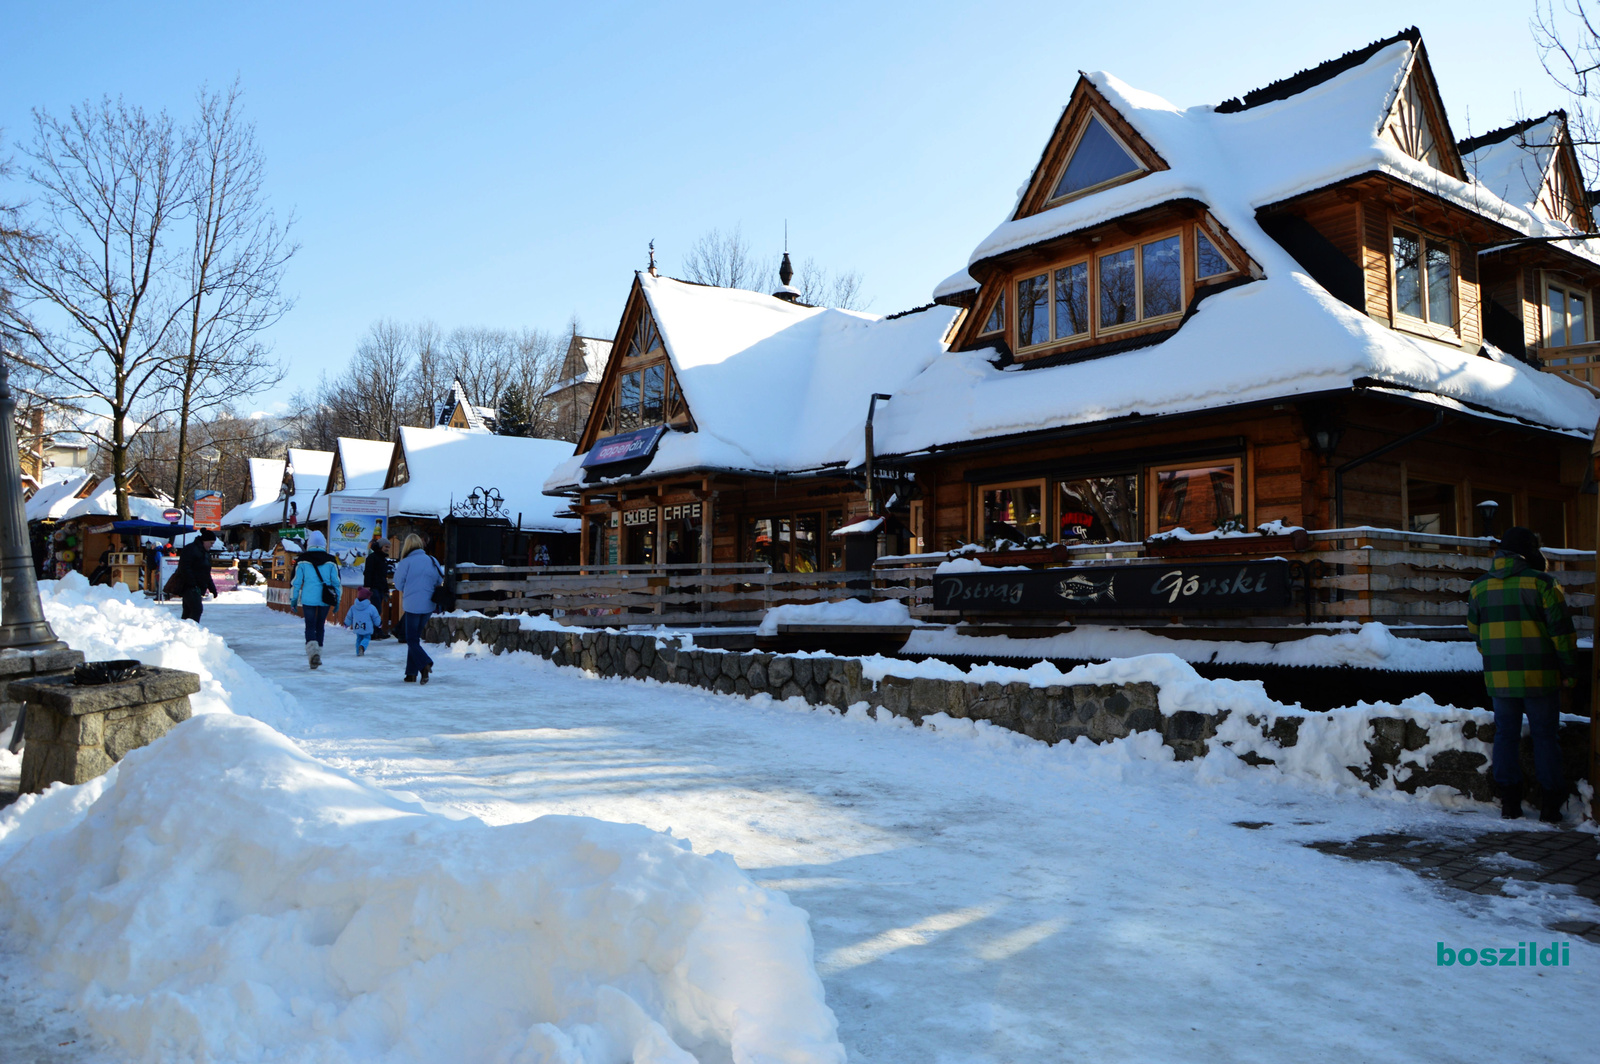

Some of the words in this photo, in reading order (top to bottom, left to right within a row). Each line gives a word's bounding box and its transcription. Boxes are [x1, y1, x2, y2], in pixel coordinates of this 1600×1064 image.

[600, 440, 645, 458] appendix
[664, 503, 701, 520] CAFE
[336, 523, 366, 534] Radler
[940, 577, 1024, 605] Pstrąg
[1150, 567, 1267, 604] Górski
